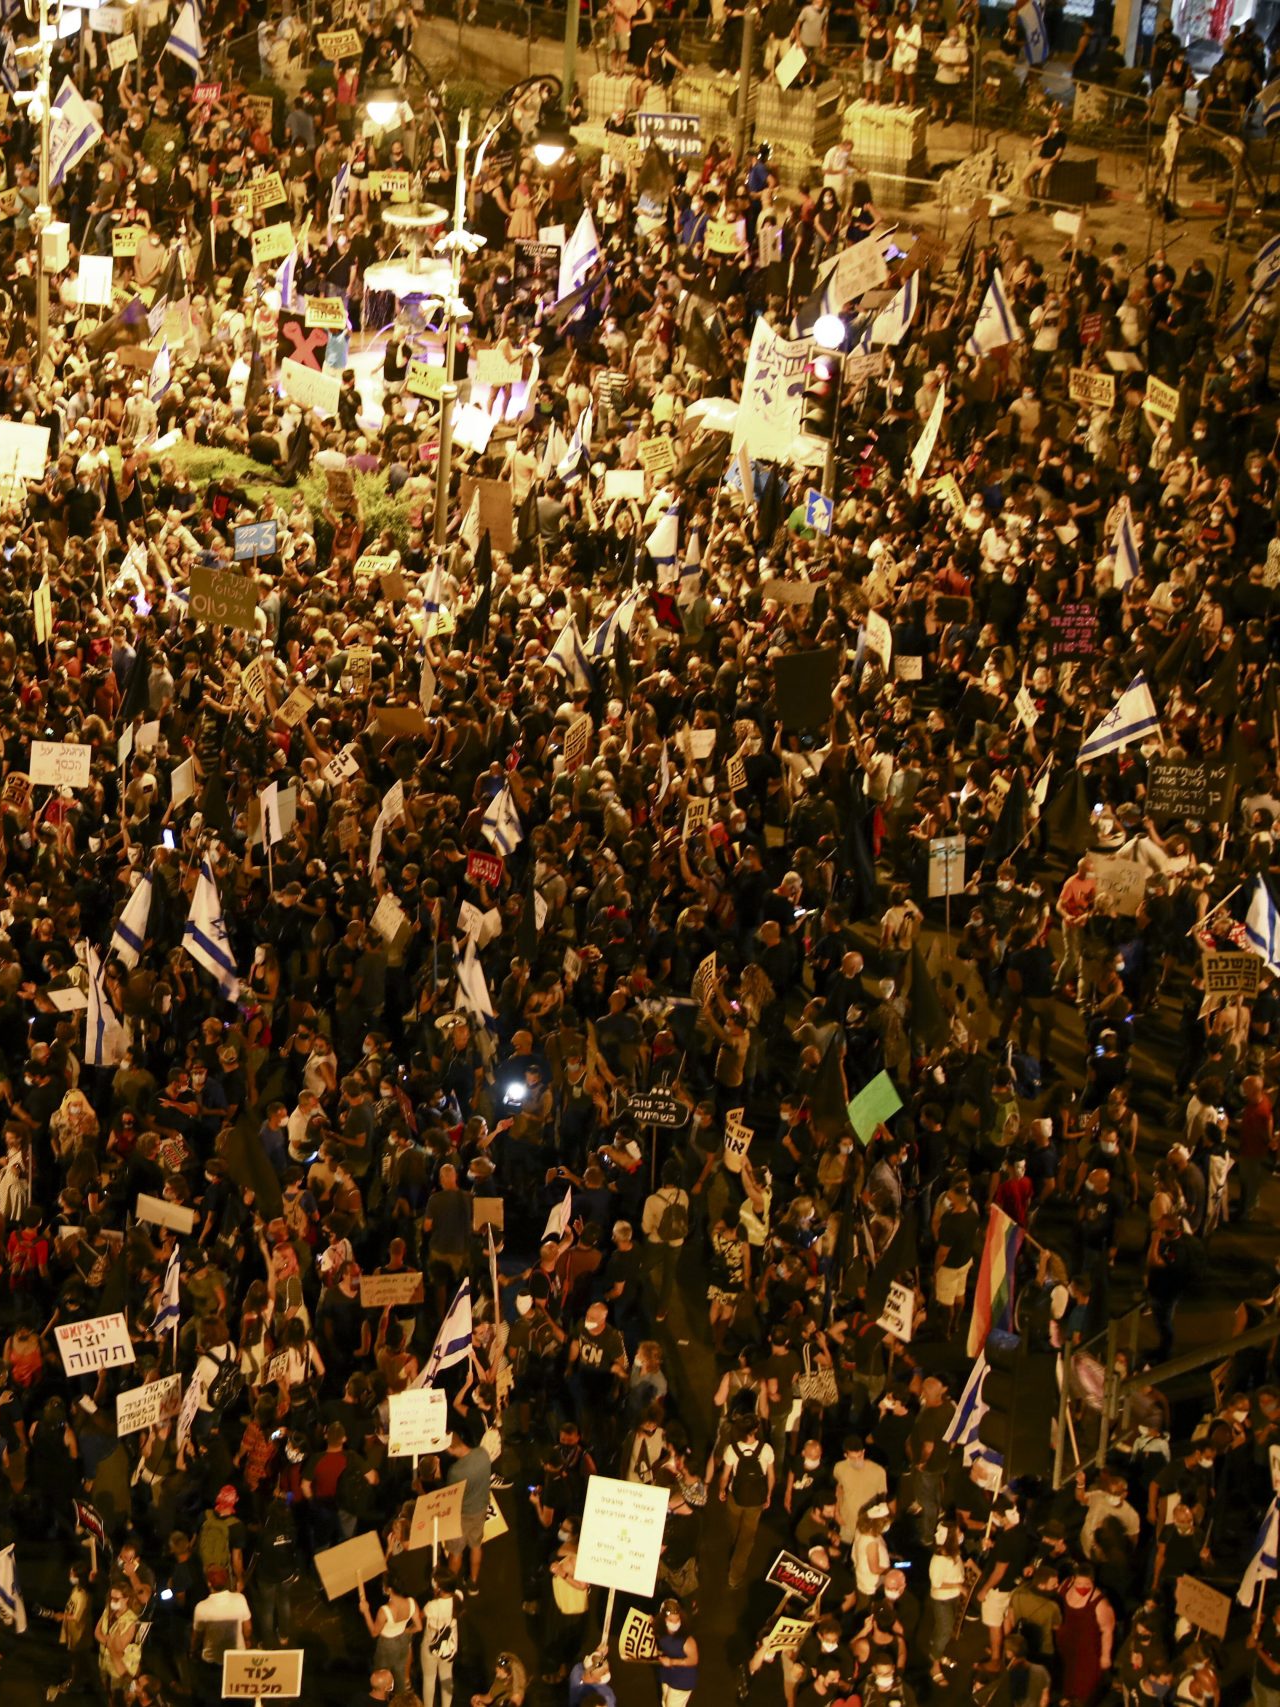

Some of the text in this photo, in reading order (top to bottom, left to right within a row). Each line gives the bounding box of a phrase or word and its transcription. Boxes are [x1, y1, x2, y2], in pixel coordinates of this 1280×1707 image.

[1207, 956, 1258, 970] נכשלת
[1207, 974, 1258, 991] הביתה!
[96, 1316, 122, 1333] דור
[72, 1333, 106, 1349] יוצר
[68, 1345, 127, 1369] תקווה
[251, 1656, 270, 1668] יש
[243, 1667, 278, 1681] עוד
